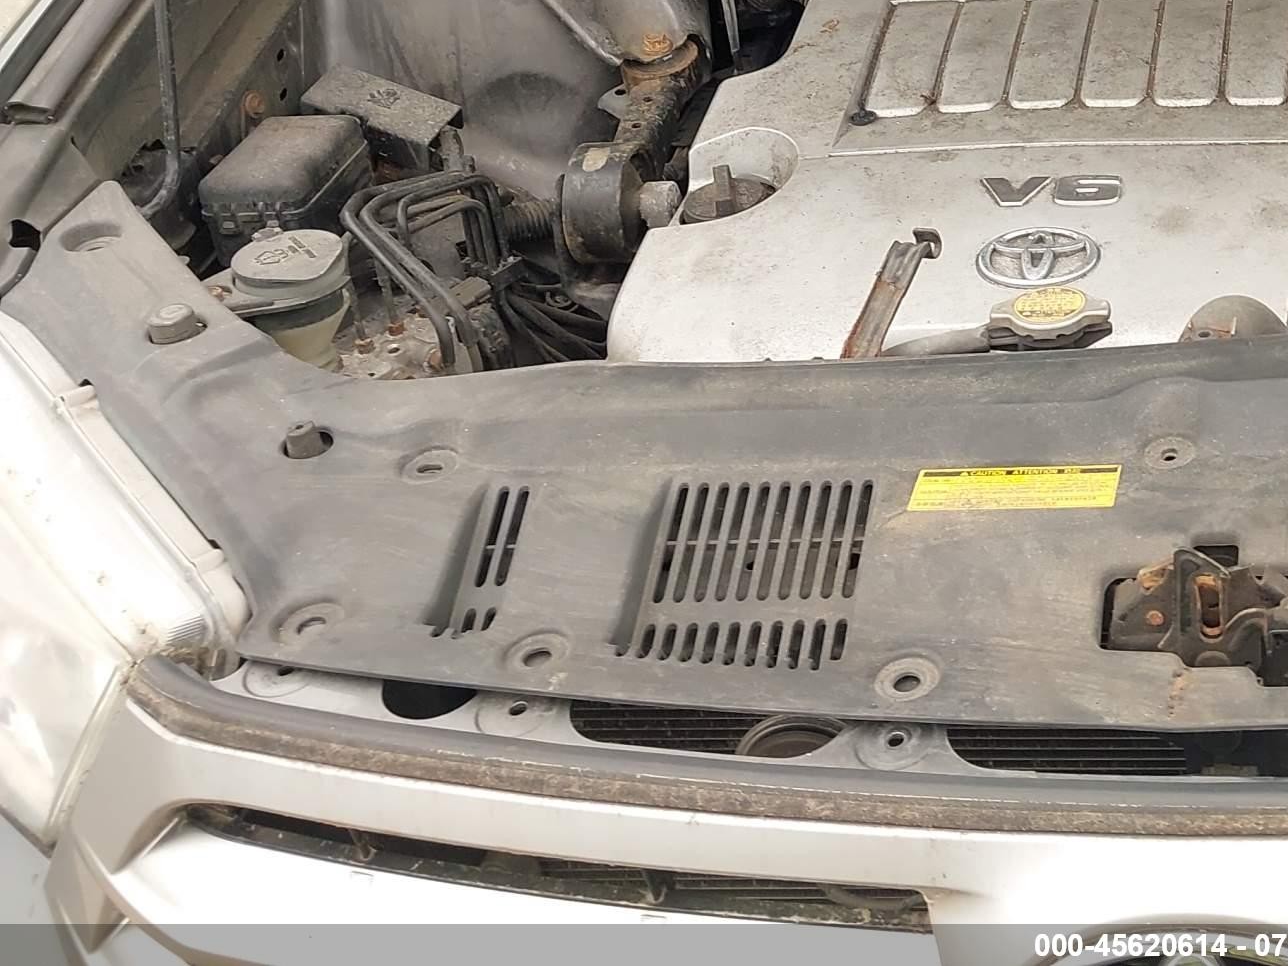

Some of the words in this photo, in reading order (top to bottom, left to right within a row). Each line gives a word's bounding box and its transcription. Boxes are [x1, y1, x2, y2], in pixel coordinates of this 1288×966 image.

[980, 174, 1122, 207] V6
[969, 469, 1007, 477] CAUTION
[1012, 468, 1058, 476] ATTENTION
